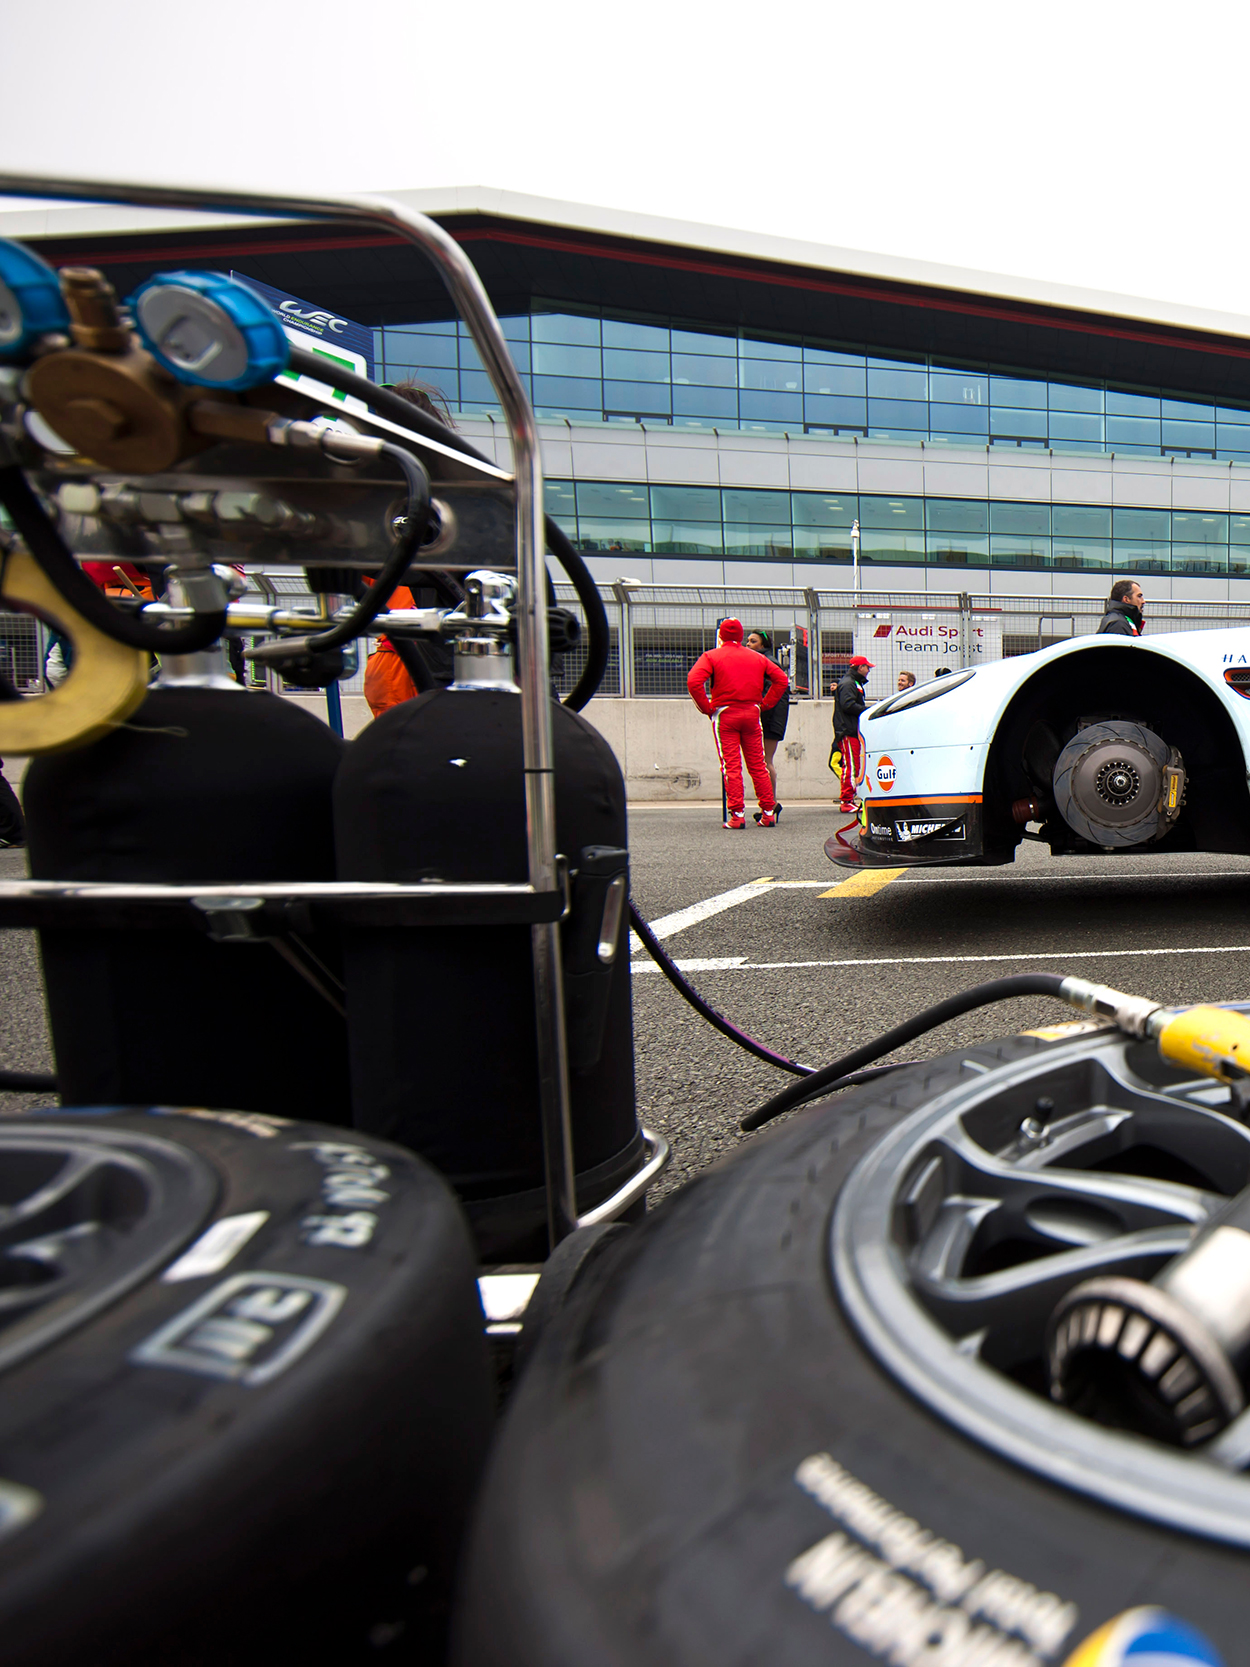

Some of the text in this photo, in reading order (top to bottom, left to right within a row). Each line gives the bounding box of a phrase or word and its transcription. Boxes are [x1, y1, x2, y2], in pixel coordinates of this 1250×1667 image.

[282, 317, 323, 336] CHAMPIONSHIP
[290, 314, 324, 332] ENDURANCE
[896, 625, 984, 639] Audi Sprt
[896, 640, 982, 654] Team Jost
[876, 768, 896, 780] Gulf
